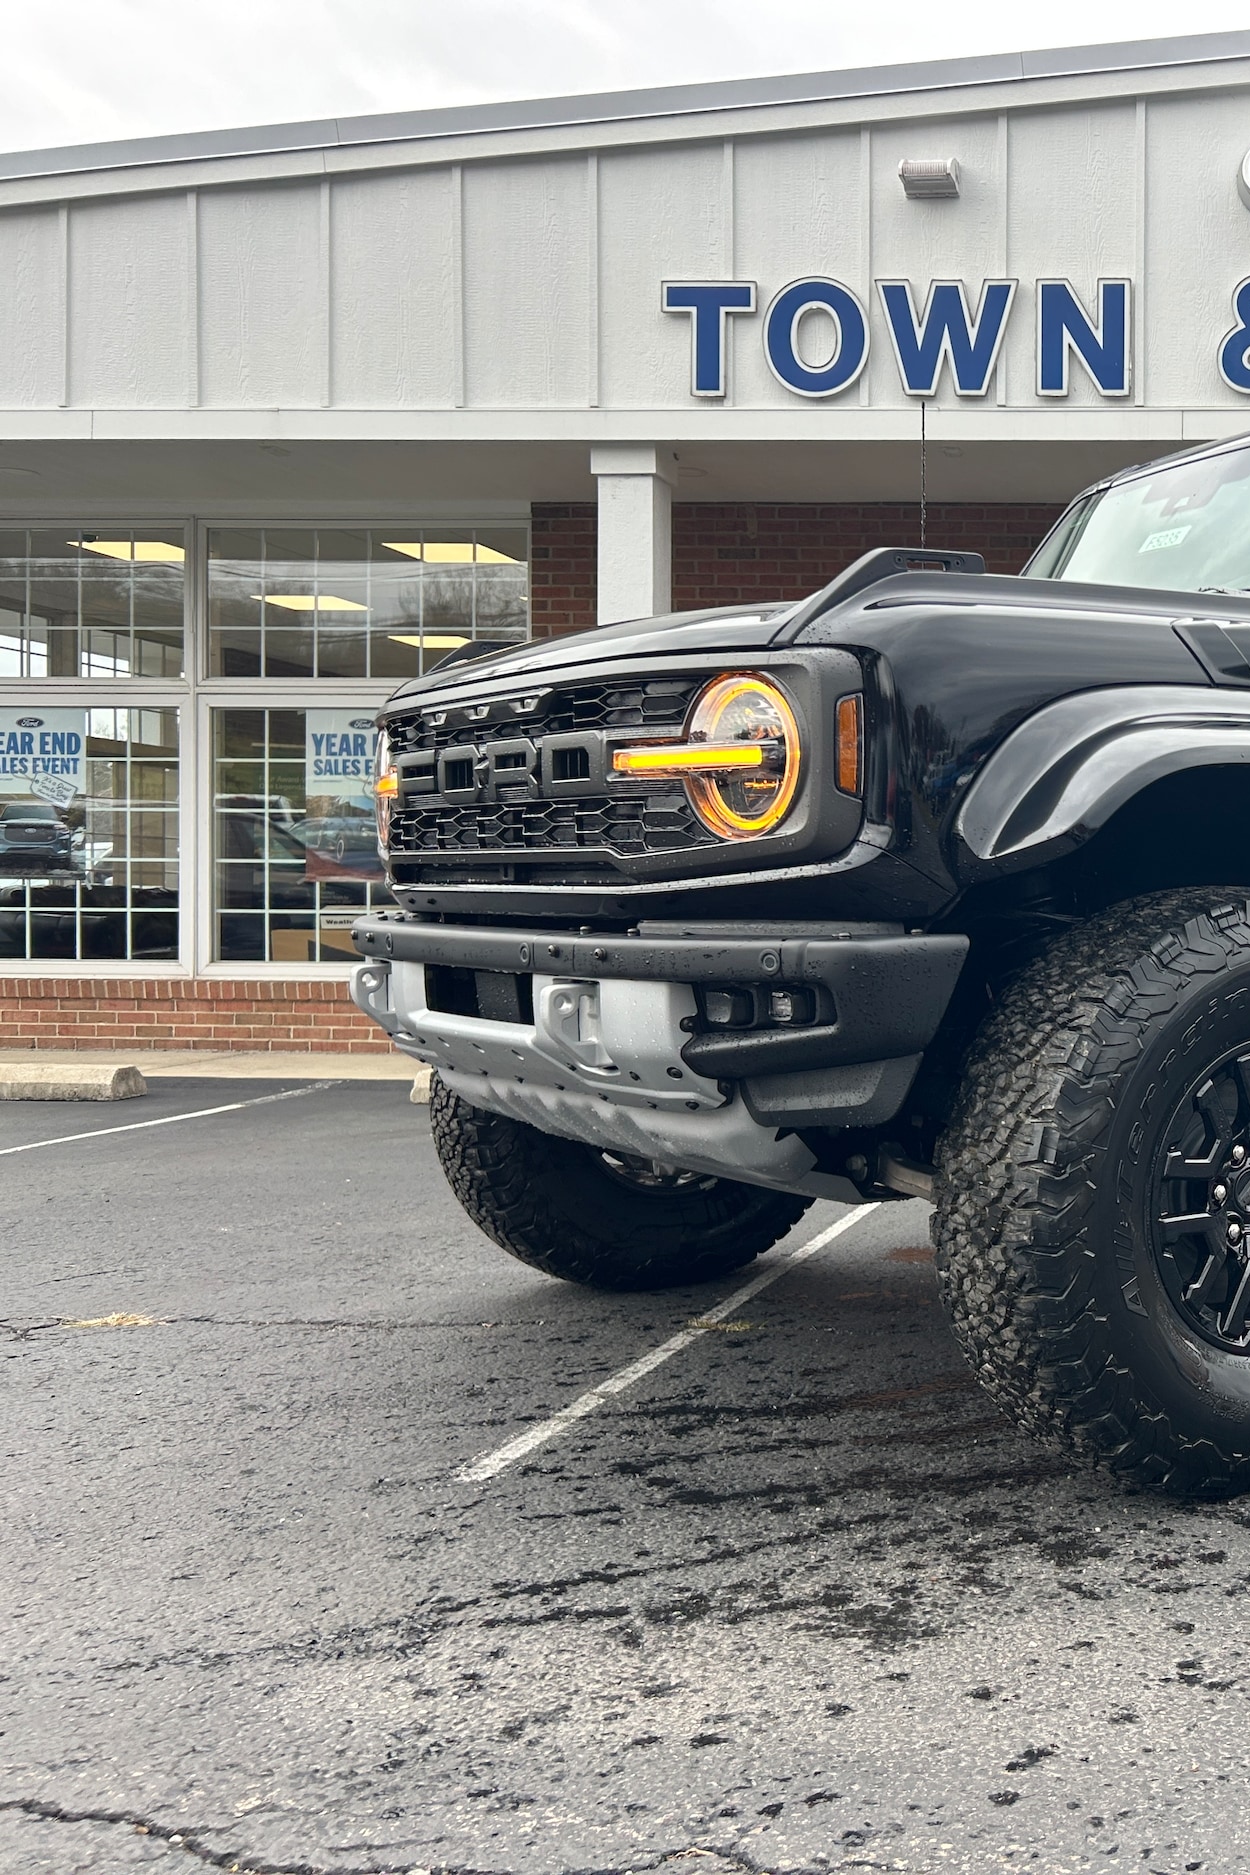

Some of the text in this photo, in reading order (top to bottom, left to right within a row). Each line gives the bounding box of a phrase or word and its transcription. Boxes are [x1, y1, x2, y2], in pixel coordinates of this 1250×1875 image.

[660, 275, 1134, 398] TOWN
[39, 732, 82, 755] END
[311, 733, 367, 756] YEAR
[0, 757, 80, 775] LES EVENT
[313, 759, 362, 776] SALES
[397, 729, 608, 809] FORD
